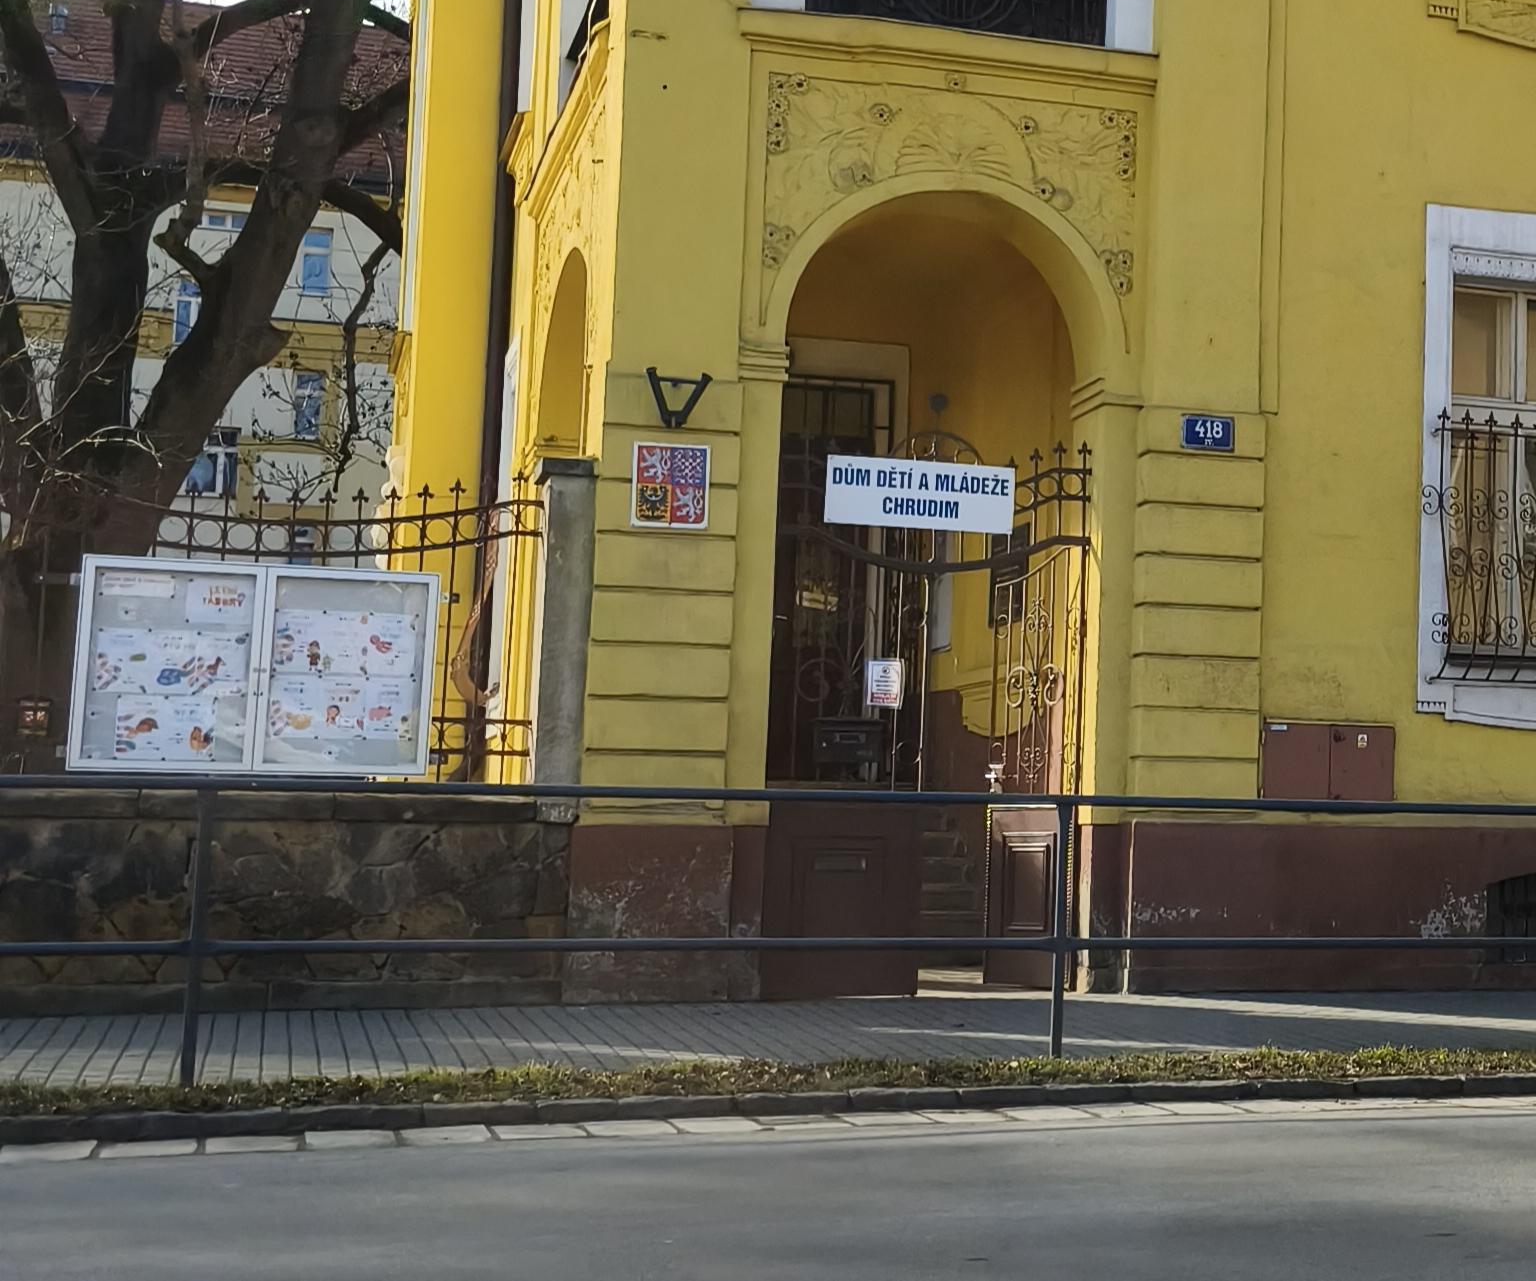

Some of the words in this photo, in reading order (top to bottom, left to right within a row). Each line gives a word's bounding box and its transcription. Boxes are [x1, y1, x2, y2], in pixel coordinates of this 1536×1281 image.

[1195, 420, 1223, 438] 418
[832, 463, 870, 487] DŮM
[876, 466, 913, 490] DĚTÍ
[918, 473, 929, 491] A
[935, 472, 1009, 496] MLÁDEŽE
[882, 496, 960, 519] CHRUDIM
